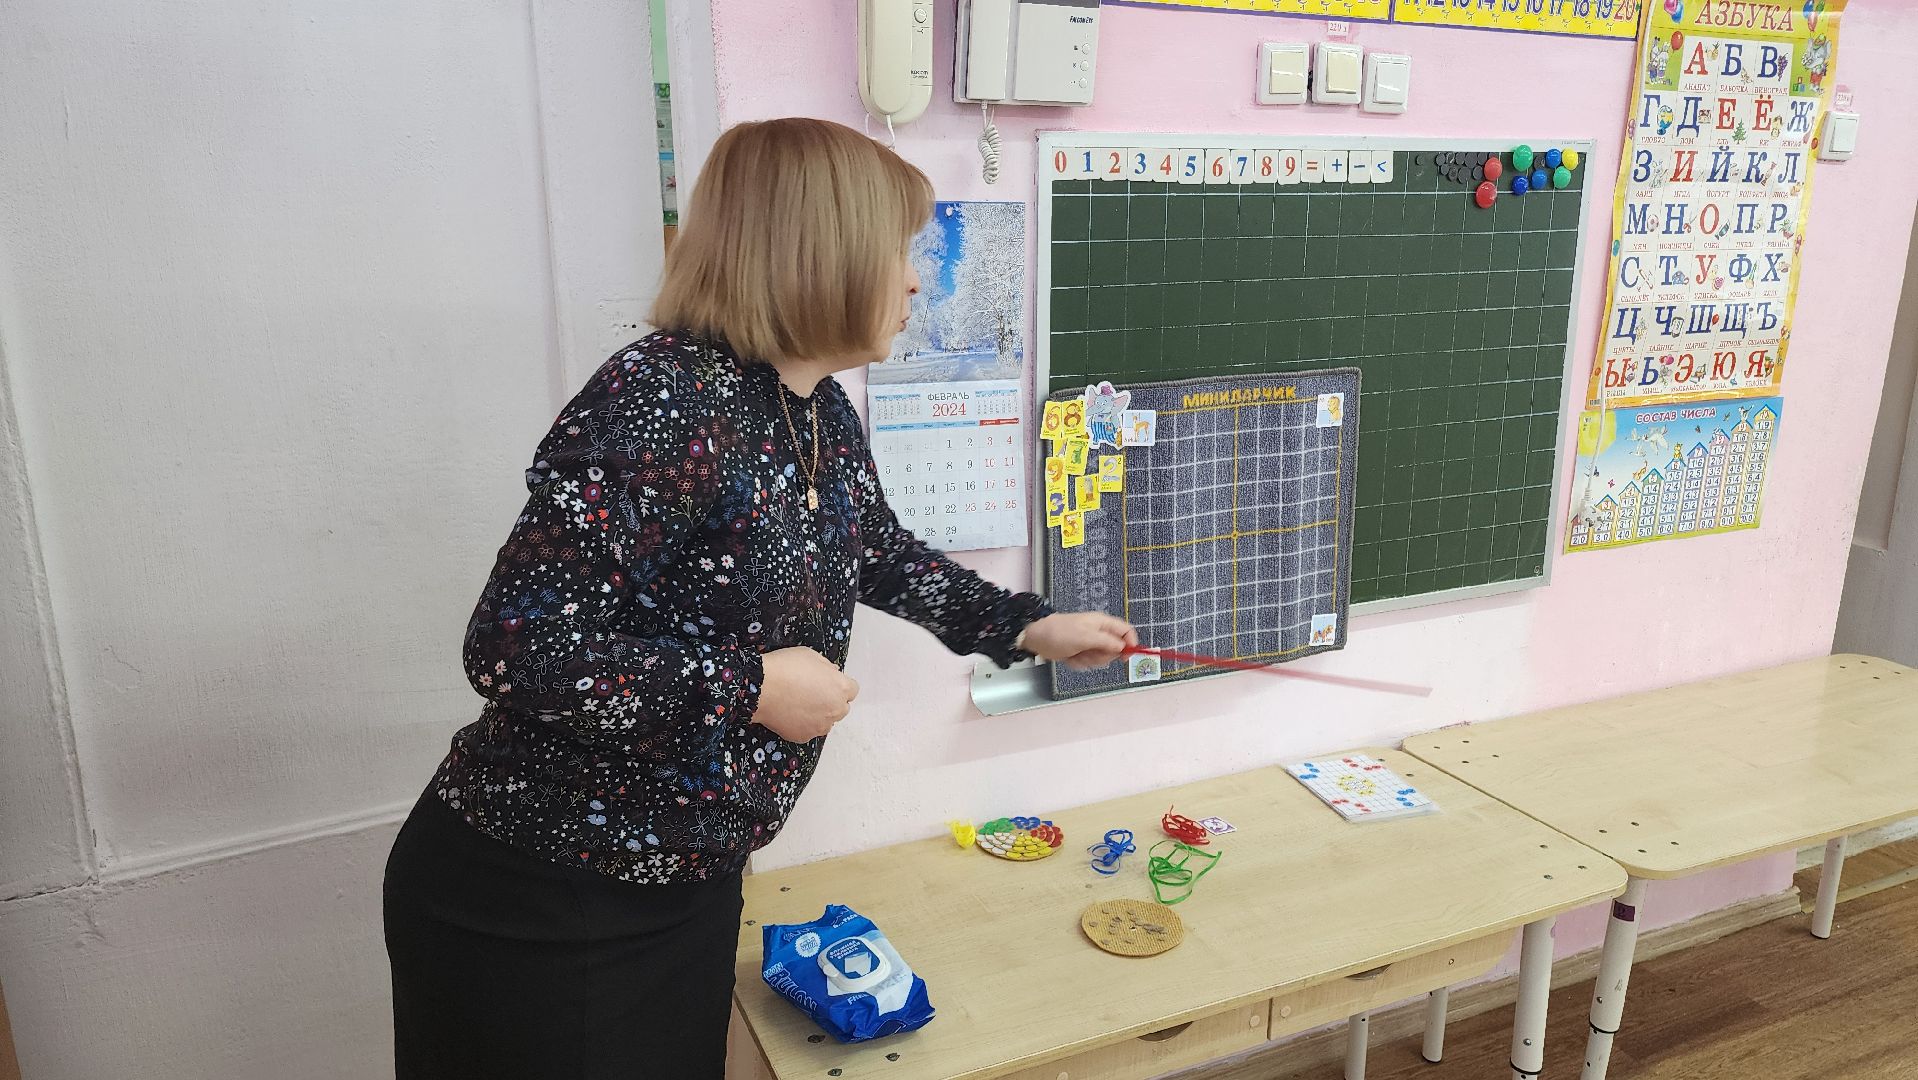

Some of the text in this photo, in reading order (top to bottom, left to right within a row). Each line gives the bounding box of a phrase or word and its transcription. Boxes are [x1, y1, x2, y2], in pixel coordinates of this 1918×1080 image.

[1595, 0, 1612, 20] 19
[1613, 0, 1636, 21] 20
[1695, 0, 1795, 32] АЗБУКА
[1684, 42, 1778, 78] А Б В
[1640, 94, 1813, 138] Г Д Е Ё Ж
[1054, 151, 1067, 173] 0
[1082, 151, 1093, 172] 1
[1108, 152, 1121, 173] 2
[1134, 153, 1147, 174] 3
[1160, 154, 1172, 175] 4
[1185, 155, 1197, 177] 5
[1212, 156, 1223, 177] 6
[1236, 156, 1248, 177] 7
[1261, 156, 1272, 177] 8
[1285, 156, 1296, 177] 9
[1307, 160, 1318, 171] =
[1331, 158, 1343, 172] +
[1633, 146, 1801, 184] З И Й К Л
[1625, 203, 1788, 235] М Н О П Р
[1620, 253, 1783, 289] С Т У Ф Х
[1612, 302, 1778, 346] Ц Ч Ш Щ Ъ
[1605, 349, 1769, 388] Ы Ь Э Ю Я
[927, 392, 970, 401] ФЕВРАЛЬ
[1183, 385, 1297, 409] МИНИЛАРЧИК
[932, 402, 967, 417] 2024
[1636, 408, 1716, 424] СОСТАВ ЧИСЛА
[967, 438, 973, 447] 2
[987, 436, 993, 446] 3
[1006, 435, 1013, 445] 4
[886, 457, 1015, 475] 5 6 7 8 9 10 11
[884, 479, 1016, 497] 12 13 14 15 16 17 18
[904, 500, 1017, 517] 20 21 22 23 24 25
[925, 527, 937, 537] 28
[945, 526, 957, 536] 29
